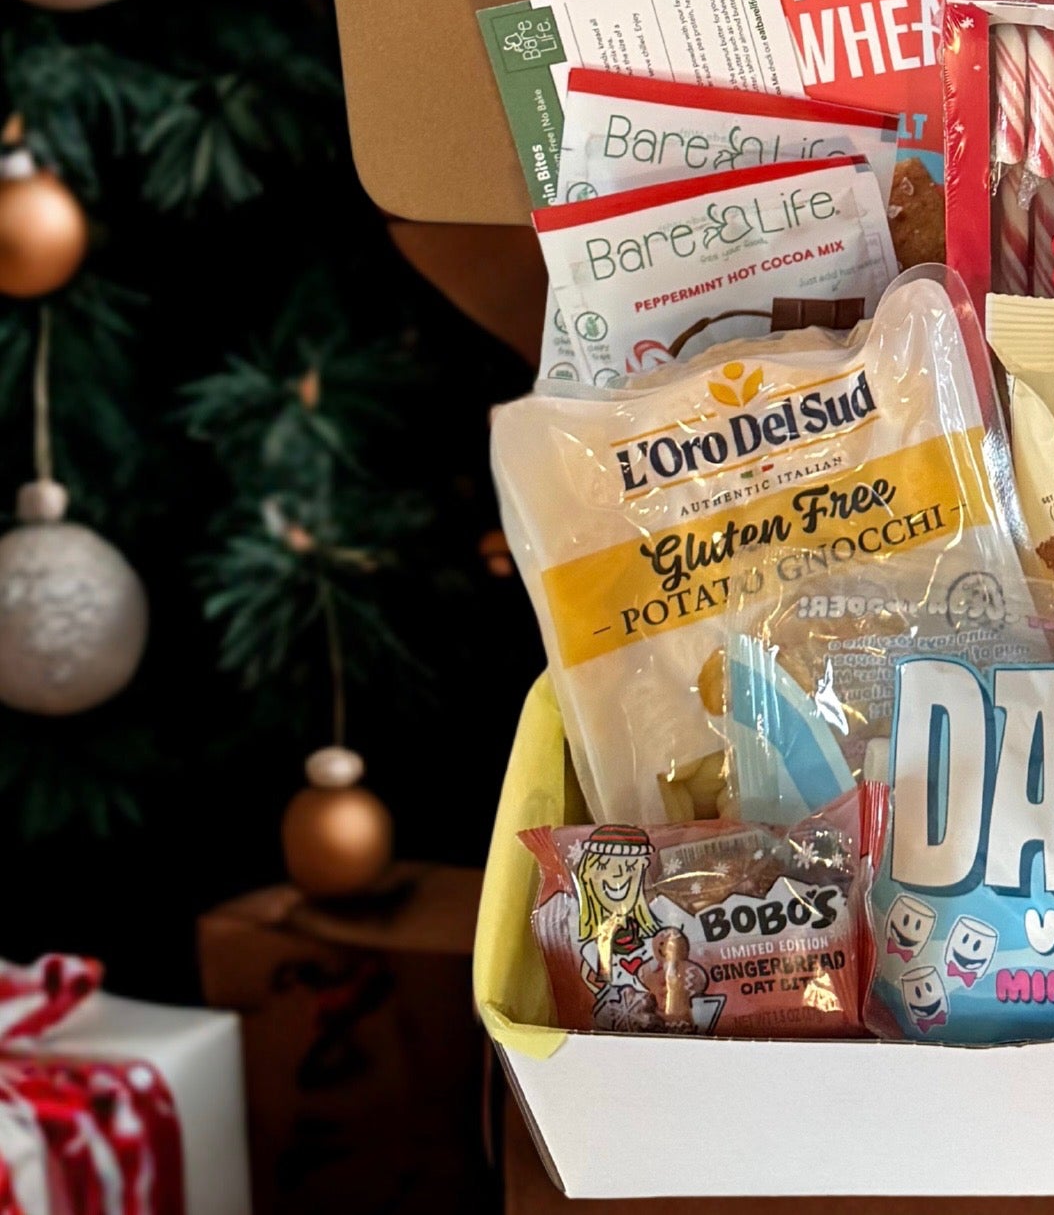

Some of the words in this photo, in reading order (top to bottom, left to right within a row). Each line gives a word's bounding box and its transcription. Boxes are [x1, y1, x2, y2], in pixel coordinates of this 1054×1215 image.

[517, 19, 542, 61] Bare
[532, 143, 551, 182] Bites
[604, 114, 709, 170] Bare
[585, 224, 696, 281] Bare
[634, 276, 724, 313] PEPPERMINT
[728, 264, 757, 283] HOT
[761, 249, 813, 272] COCOA
[817, 239, 845, 257] MIX
[616, 430, 729, 492] L'Oro
[730, 399, 800, 457] Del
[802, 369, 877, 434] Sud
[681, 480, 771, 518] AUTHENTIC
[777, 457, 843, 487] ITALIAN
[639, 513, 792, 593] Gluten
[792, 478, 896, 536] Free
[776, 503, 947, 584] GNOCCHI
[699, 889, 838, 942] BOBO'S
[710, 950, 846, 983] GINGERBREAD
[720, 941, 774, 960] LIMITED
[779, 936, 829, 952] EDITION
[741, 980, 776, 996] OAT
